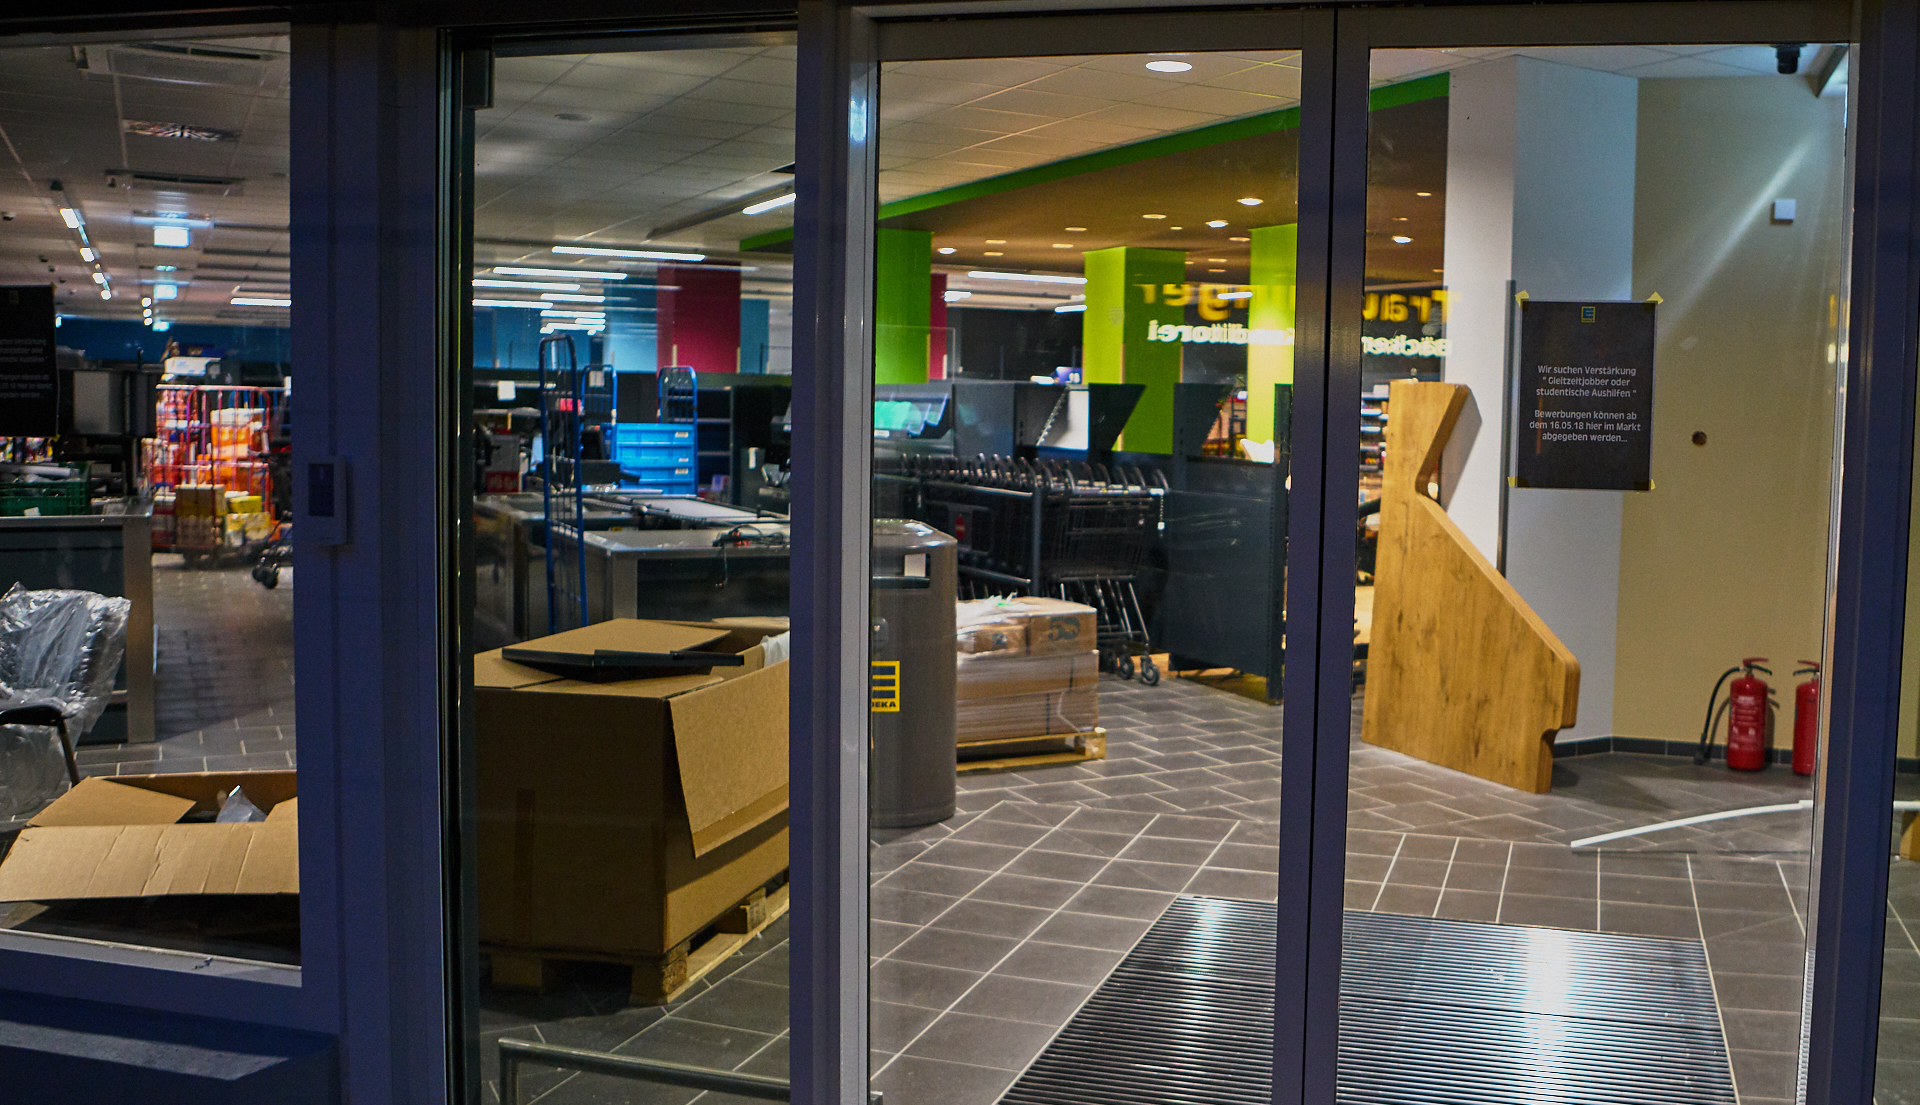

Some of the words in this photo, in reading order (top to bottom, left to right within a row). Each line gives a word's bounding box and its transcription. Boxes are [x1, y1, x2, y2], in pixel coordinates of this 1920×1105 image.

[1538, 365, 1552, 374] Wir
[1553, 365, 1583, 374] suchen
[1585, 366, 1637, 376] Verstärkung
[1548, 376, 1609, 386] Gleitzeitjobber
[1610, 377, 1631, 386] oder
[1536, 388, 1590, 397] studentische
[1591, 388, 1631, 397] Aushilfen
[1534, 409, 1592, 420] Bewerbungen
[1593, 410, 1625, 420] können
[1626, 411, 1637, 420] ab
[1529, 420, 1548, 429] dem
[1549, 421, 1584, 430] 16.05.18
[1585, 422, 1603, 430] hier
[1603, 422, 1615, 430] im
[1616, 423, 1642, 431] Markt
[1542, 432, 1588, 442] abgegeben
[1589, 433, 1628, 442] werden...
